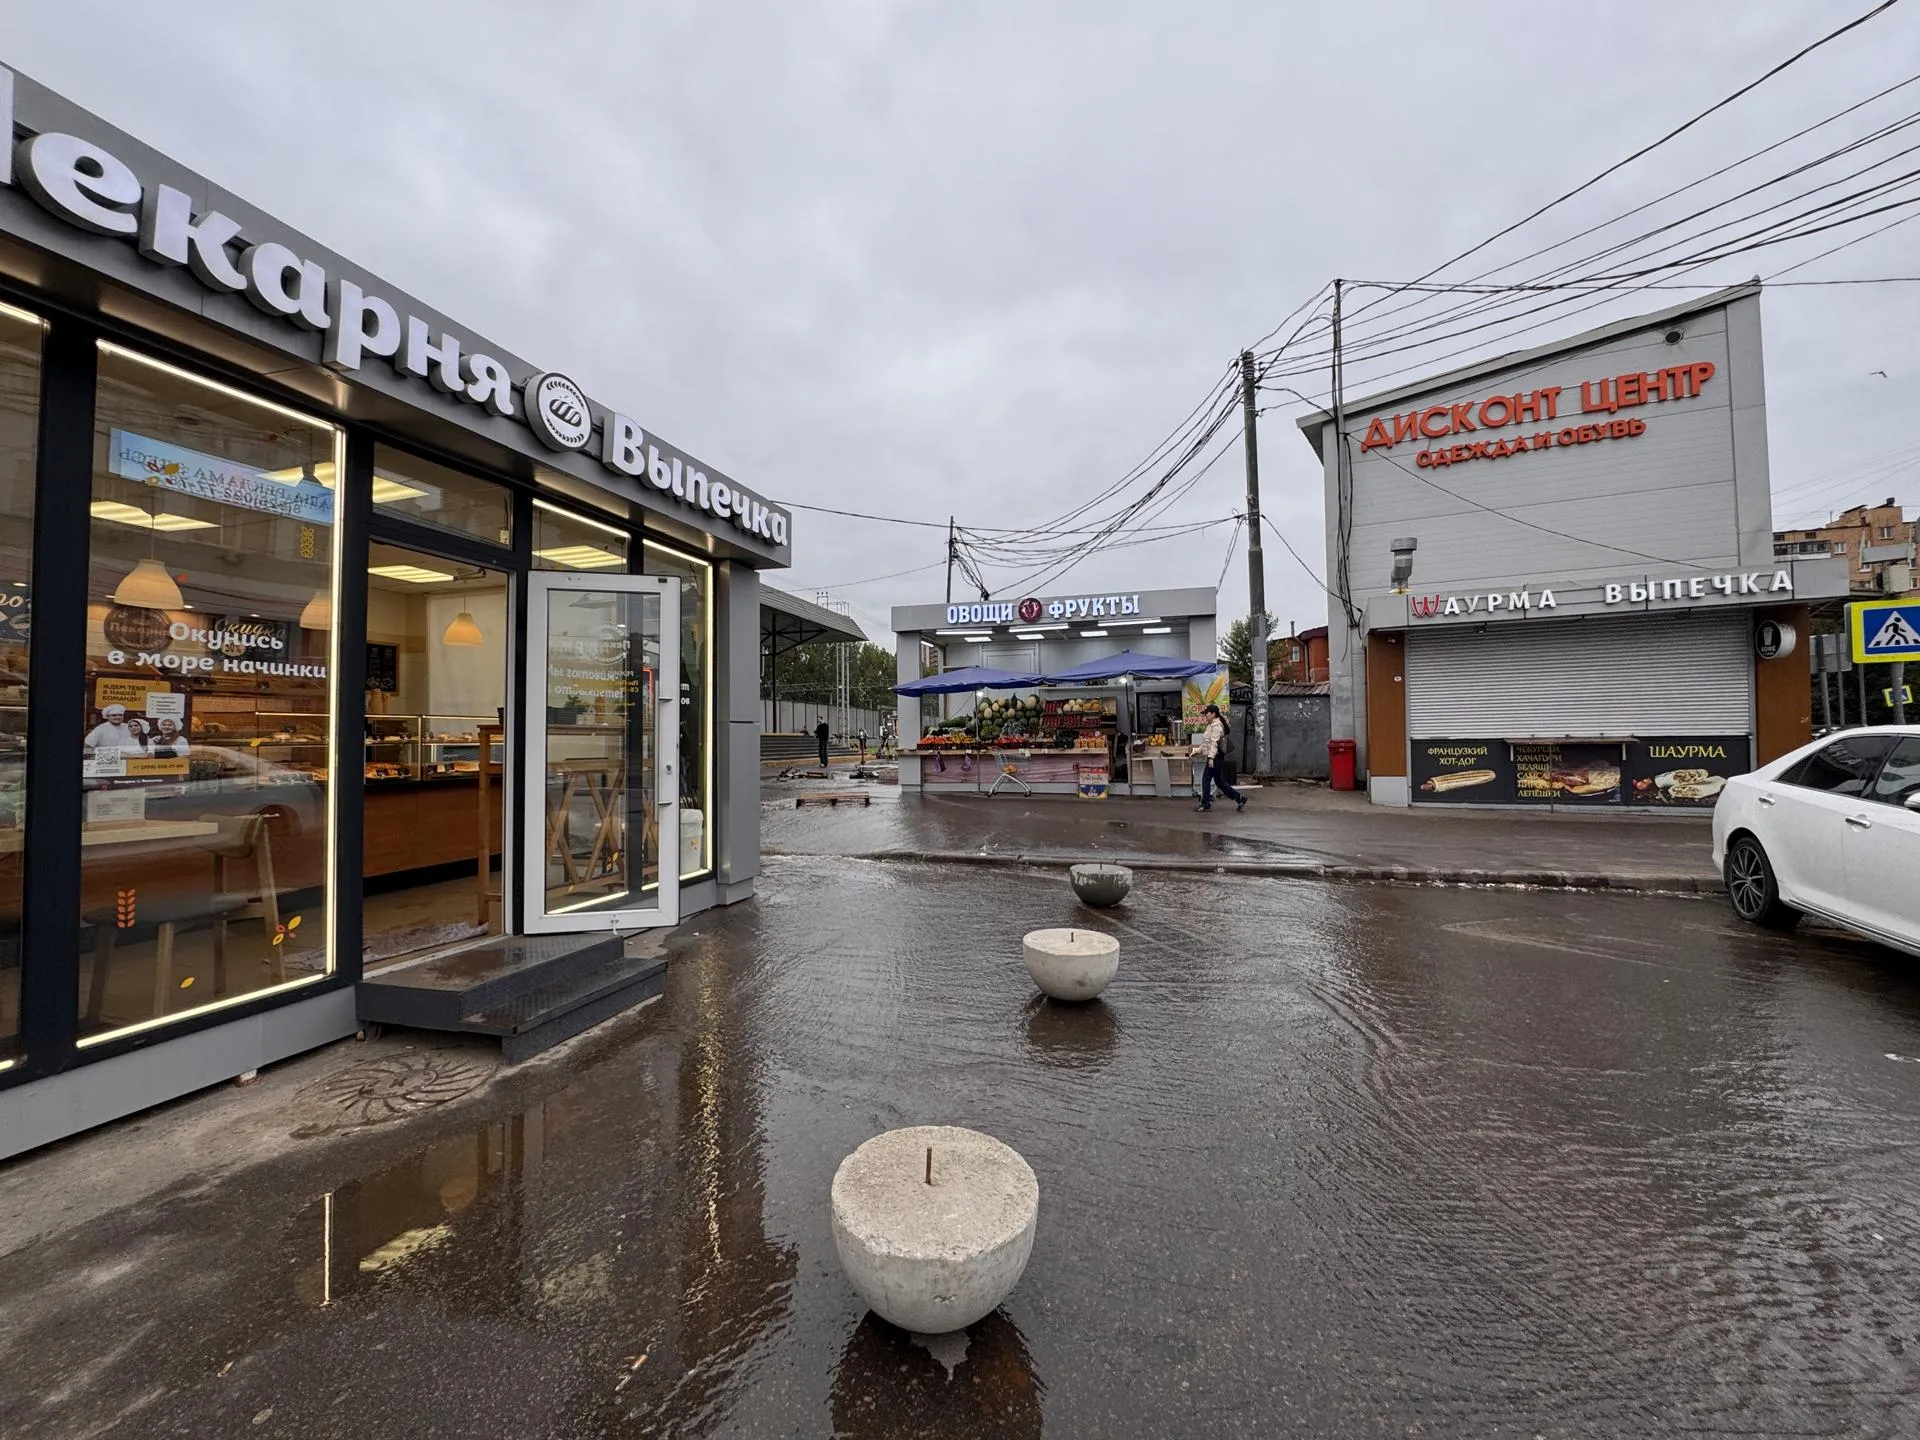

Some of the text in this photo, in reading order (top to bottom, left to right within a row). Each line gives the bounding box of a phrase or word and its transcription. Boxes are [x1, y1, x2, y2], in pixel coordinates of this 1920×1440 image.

[1360, 361, 1716, 453] ДИСКОНТ ЦЕНТР
[1415, 417, 1646, 468] ОДЕЖДА И ОБУВЬ
[605, 413, 788, 547] Выпечка
[1604, 570, 1794, 604] ВЫПЕЧКА
[946, 595, 1140, 625] ОВОЩИ ФРУКТЫ
[169, 622, 284, 650] Окунись
[107, 650, 327, 679] в море начинки
[1427, 746, 1488, 757] ФРАНЦУЗКИЙ
[1439, 757, 1477, 767] ХОТ-ДОГ
[1516, 754, 1562, 762] ХАЧАПУРИ
[1649, 745, 1727, 758] ШАУРМА
